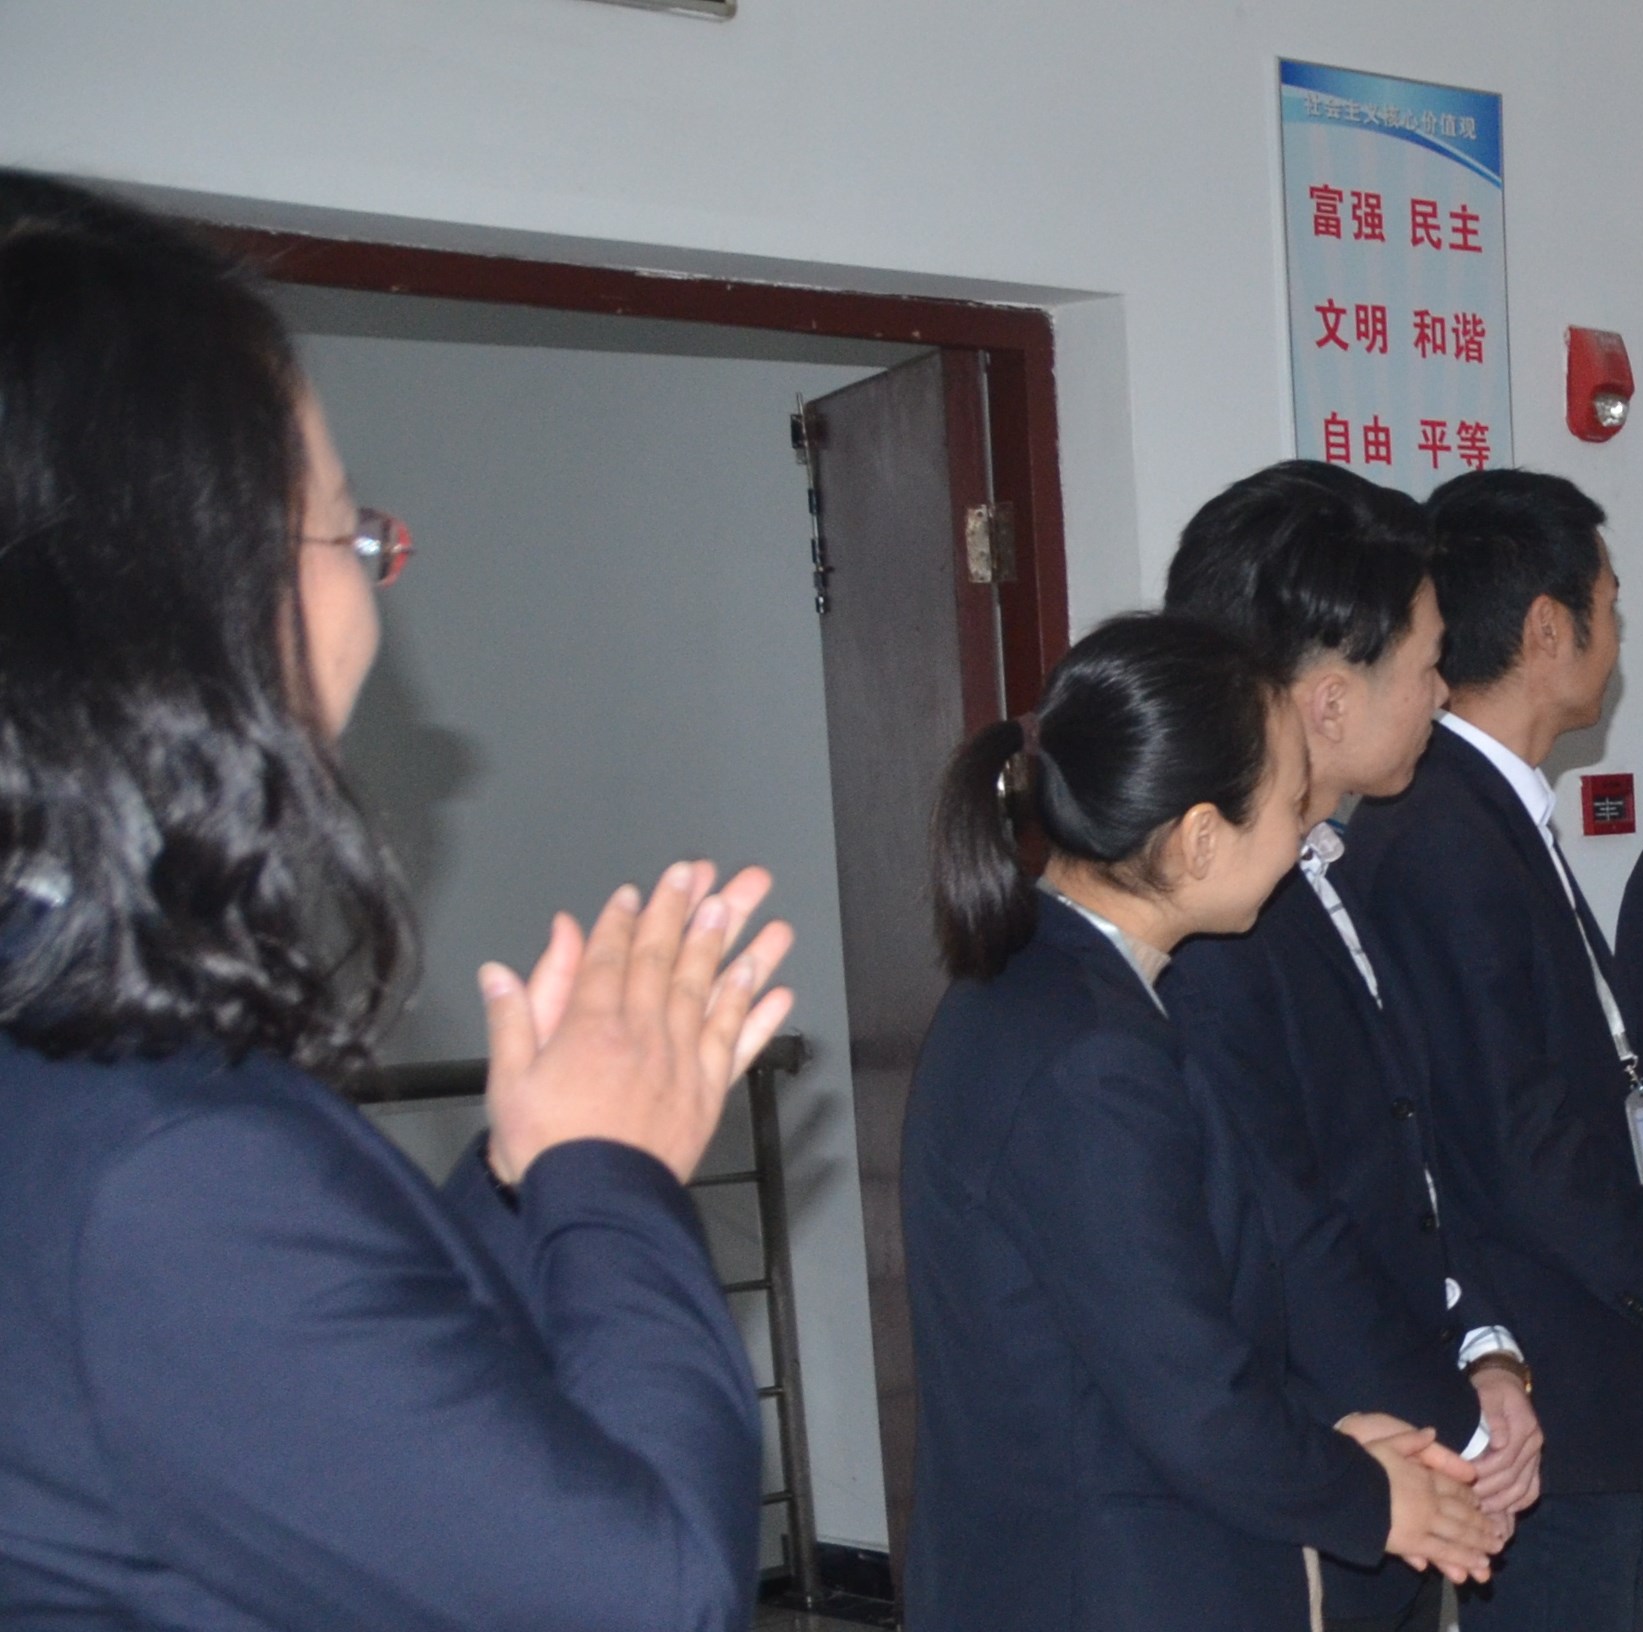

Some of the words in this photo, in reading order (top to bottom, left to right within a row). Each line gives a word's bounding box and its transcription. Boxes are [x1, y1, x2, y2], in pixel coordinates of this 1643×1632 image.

[1304, 93, 1477, 140] 社会主义核心价值观
[1309, 184, 1386, 243] 富强
[1410, 198, 1483, 253] 民主
[1315, 299, 1390, 354] 文明
[1413, 310, 1486, 364] 和谐
[1323, 412, 1393, 466] 自由
[1418, 419, 1491, 471] 平等
